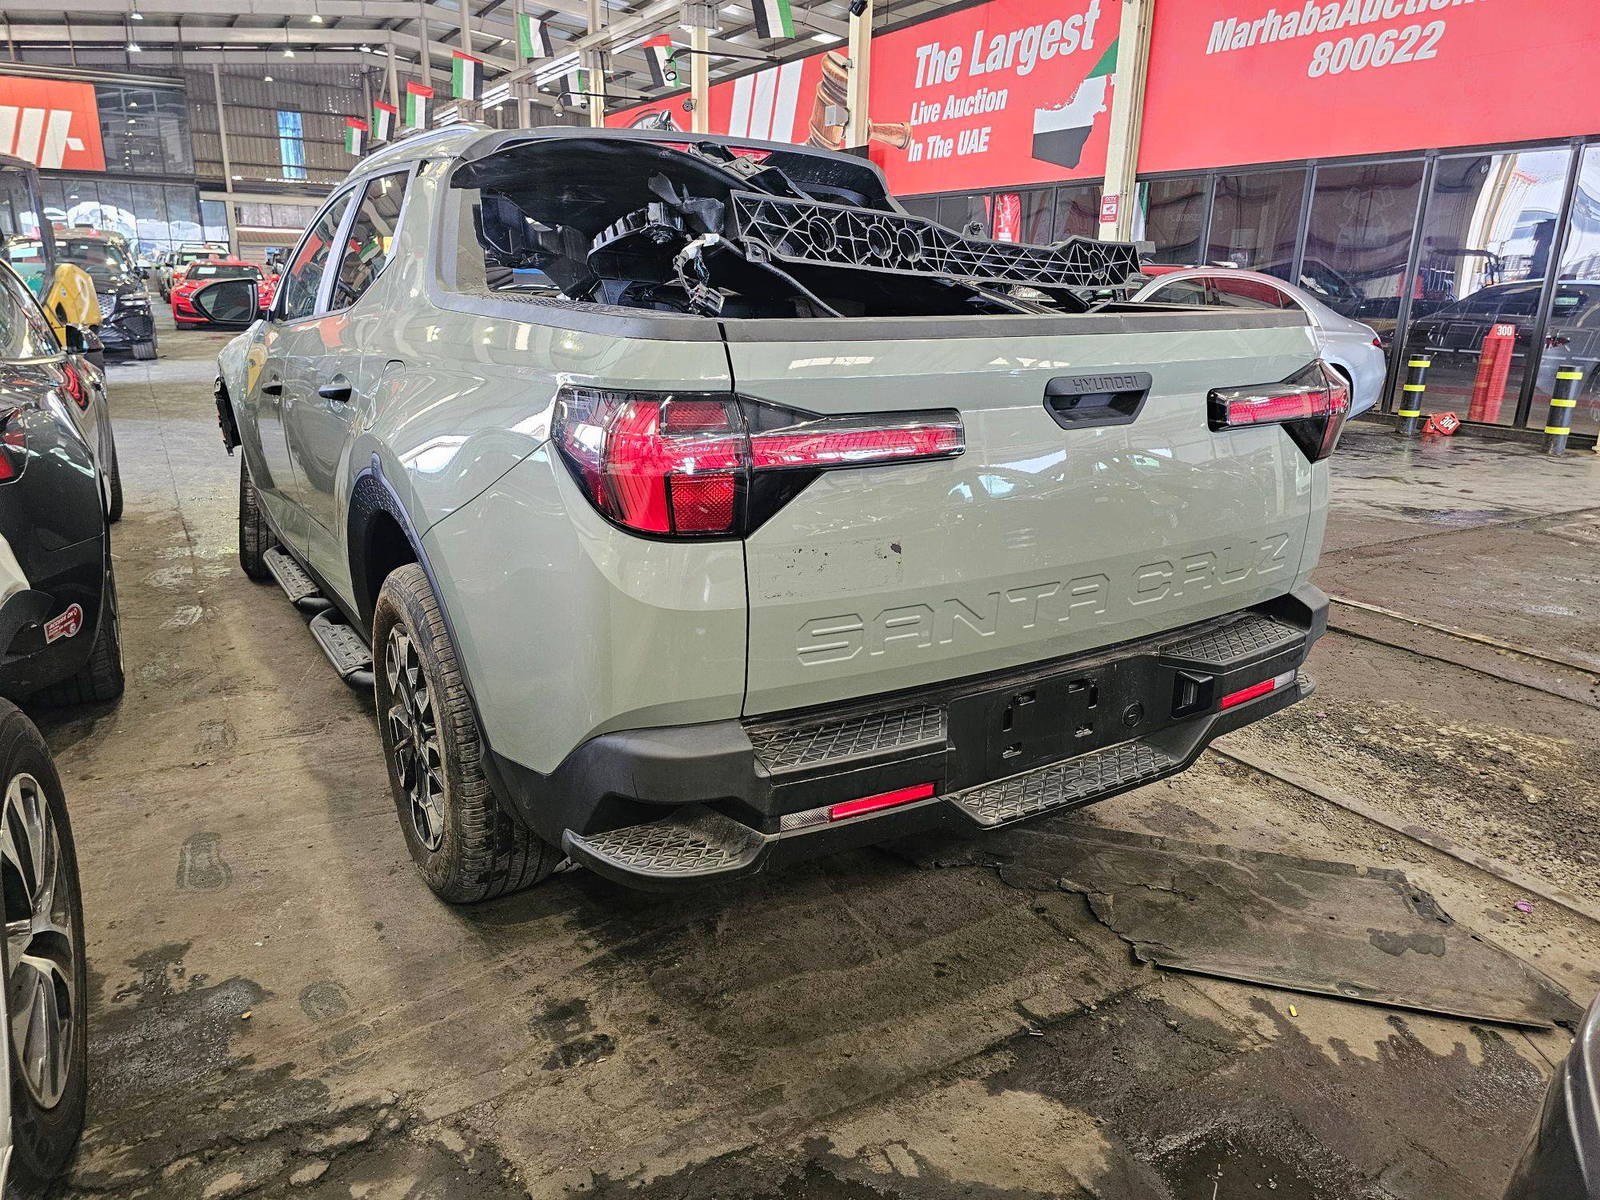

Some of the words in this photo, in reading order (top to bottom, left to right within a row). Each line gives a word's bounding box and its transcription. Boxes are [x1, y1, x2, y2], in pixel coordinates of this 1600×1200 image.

[914, 42, 962, 88] The
[968, 0, 1101, 76] Largest
[1205, 0, 1478, 55] MarhabaAuc
[1307, 20, 1447, 78] 800622
[910, 100, 941, 126] Live
[942, 87, 1008, 121] Auction
[908, 139, 923, 162] In
[926, 134, 954, 160] The
[957, 126, 992, 156] UAE
[1497, 326, 1513, 336] 300
[1072, 376, 1140, 393] HYUNDAI
[1439, 415, 1457, 431] 304
[796, 572, 1111, 667] SANTA
[1127, 532, 1289, 606] CRUZ
